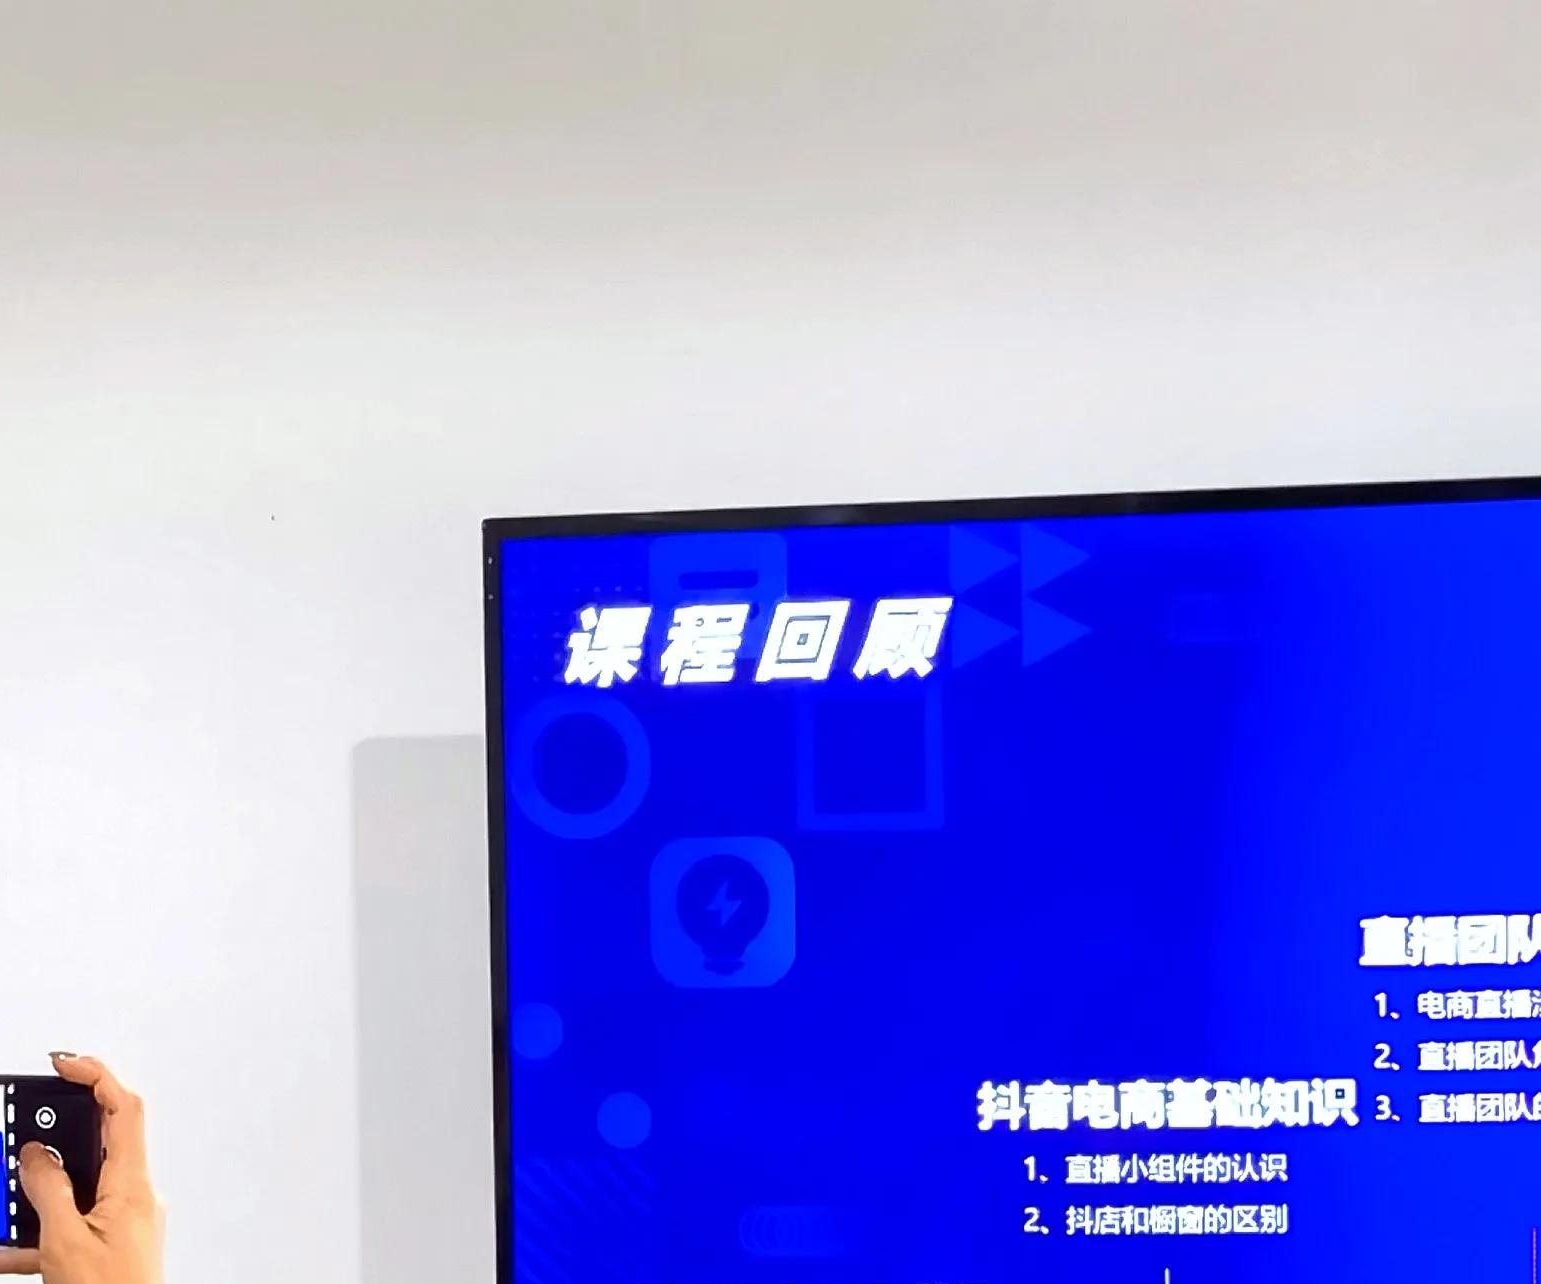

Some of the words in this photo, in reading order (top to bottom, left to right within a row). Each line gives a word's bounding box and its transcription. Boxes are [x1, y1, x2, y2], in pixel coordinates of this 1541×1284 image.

[564, 597, 954, 688] 课程回顾
[976, 1077, 1359, 1131] 抖音电商基础知识
[1023, 1153, 1288, 1184] 1、直播小组件的认识
